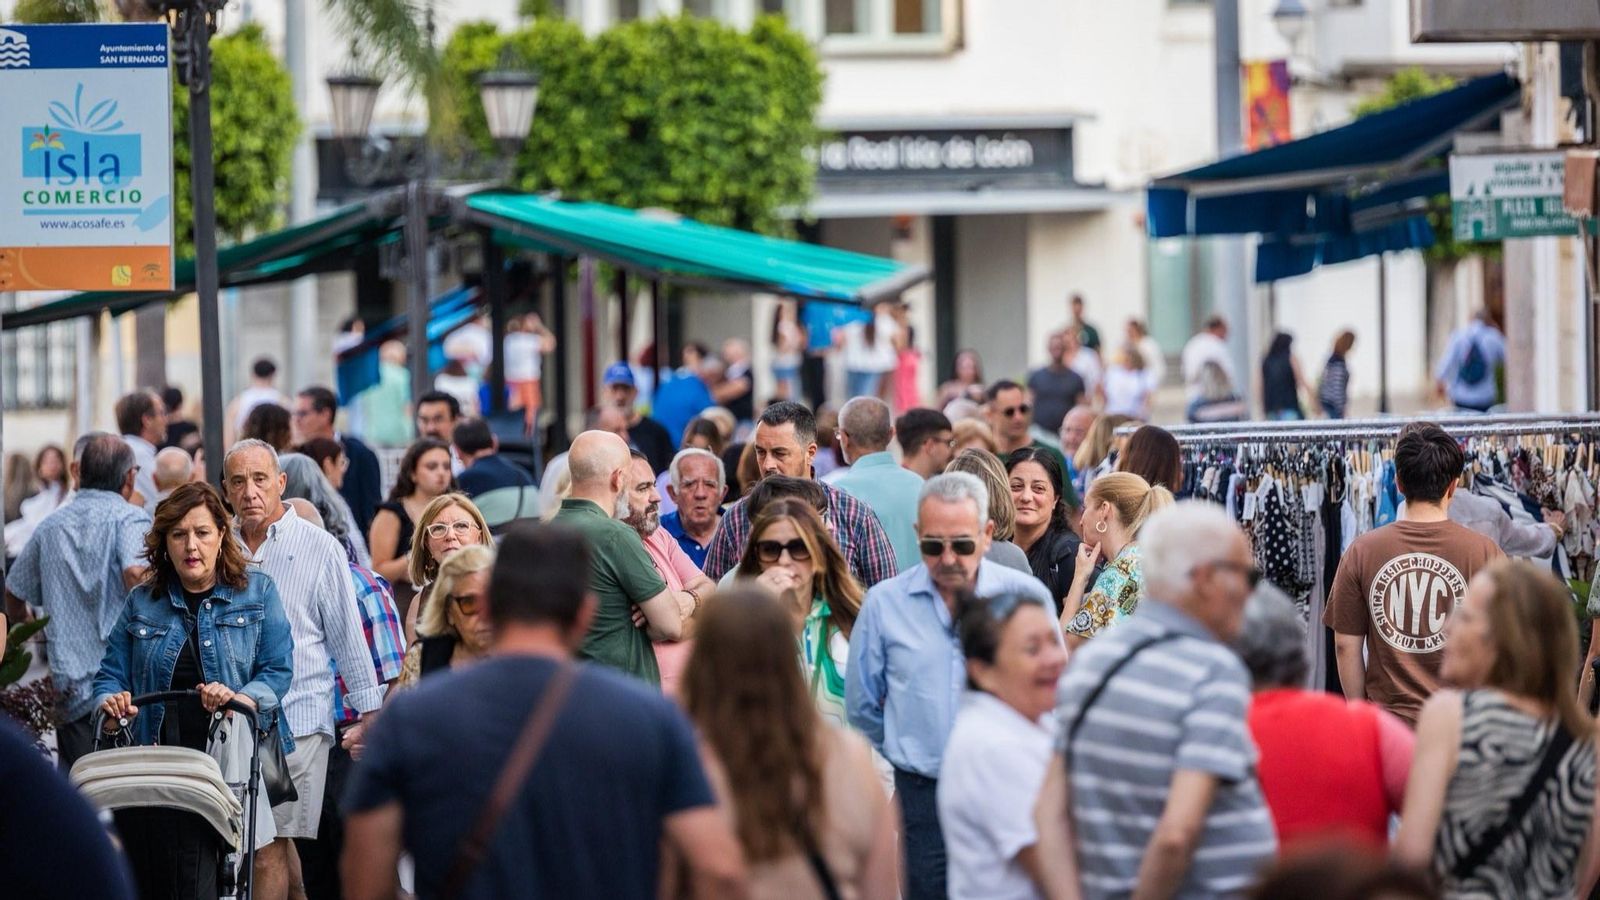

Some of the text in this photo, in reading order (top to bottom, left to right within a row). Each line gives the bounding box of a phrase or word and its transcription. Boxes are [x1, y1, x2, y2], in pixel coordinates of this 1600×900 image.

[100, 43, 165, 53] Ayuntamiento de
[100, 55, 165, 64] SAN FERNANDO
[44, 141, 121, 186] isla
[848, 136, 900, 169] Real
[942, 134, 975, 168] de
[976, 132, 1033, 168] León
[23, 189, 142, 205] COMERCIO
[40, 217, 125, 230] www.acosafe.es
[1373, 589, 1386, 626] SINCE
[1389, 571, 1448, 636] NYC
